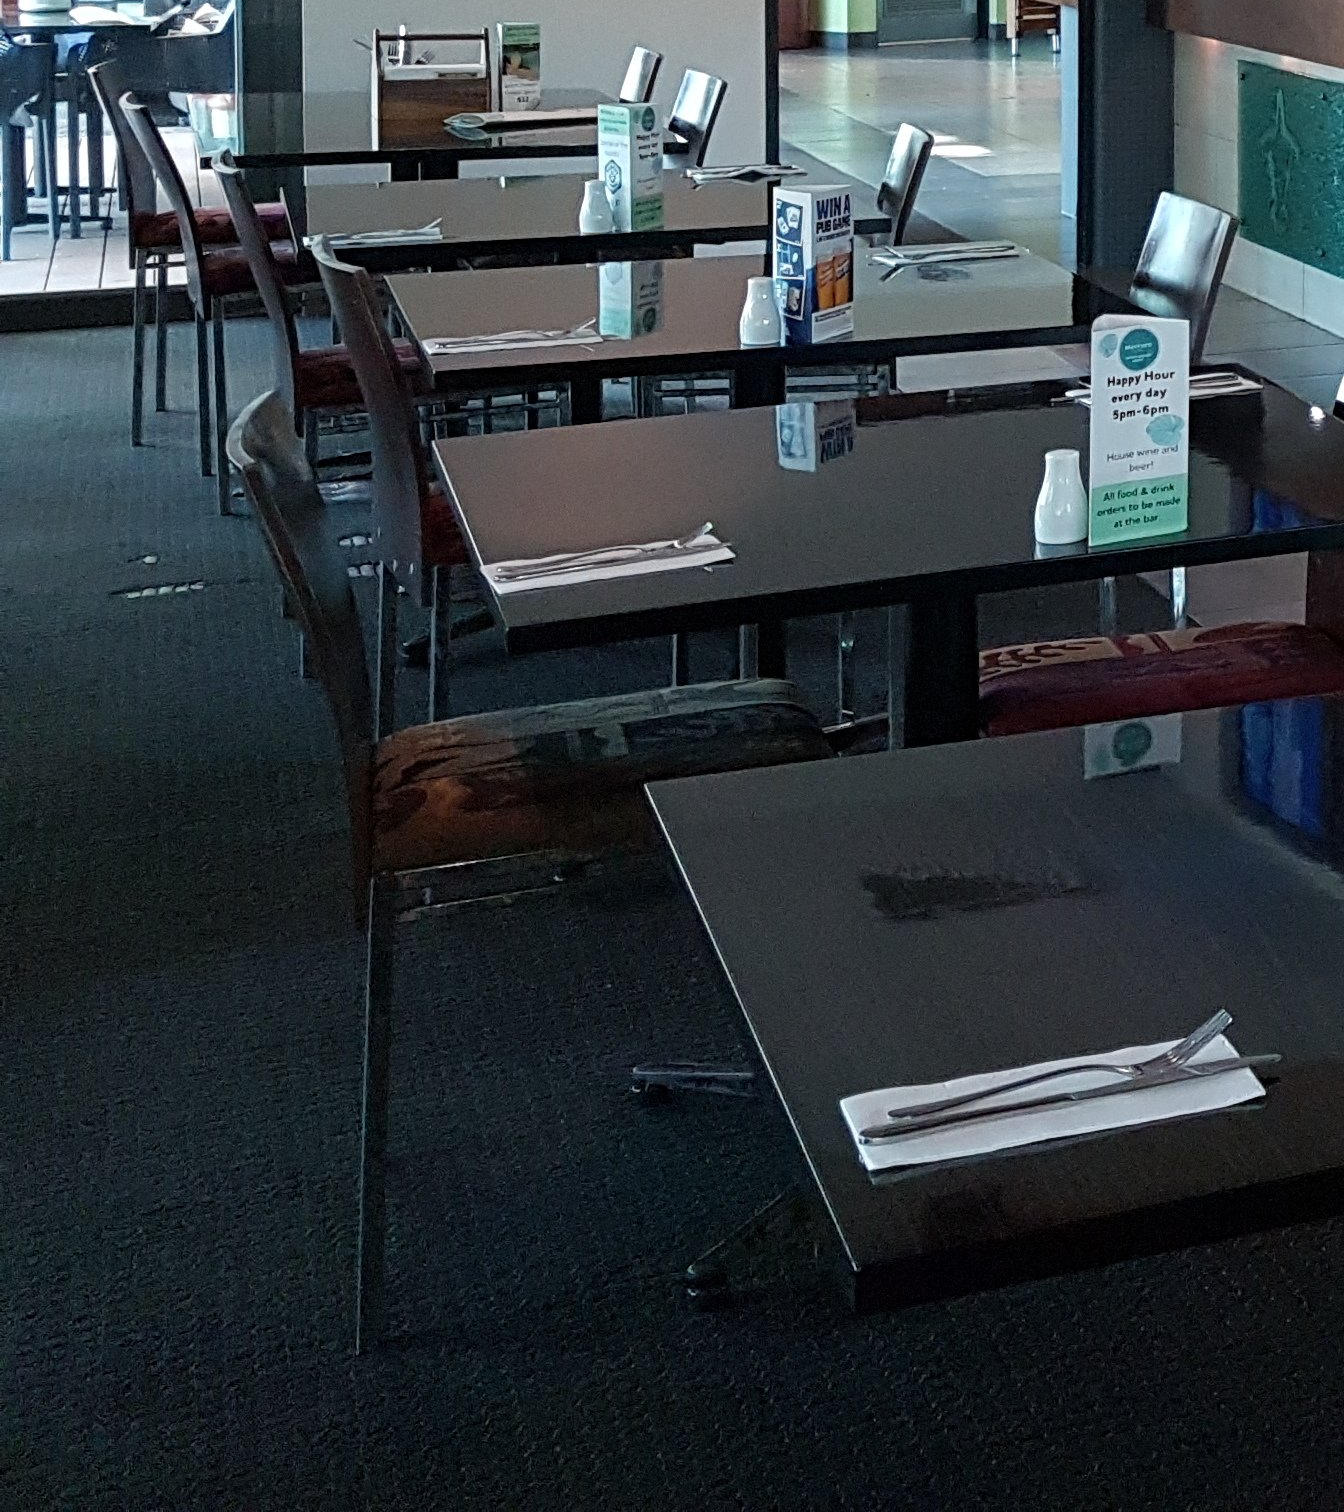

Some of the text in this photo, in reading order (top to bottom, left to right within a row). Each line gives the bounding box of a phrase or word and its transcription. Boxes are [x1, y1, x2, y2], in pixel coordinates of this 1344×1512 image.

[816, 193, 851, 220] WIN A
[1107, 370, 1175, 388] Happy Hour
[1111, 387, 1167, 403] every day
[1112, 404, 1169, 421] 5pm-6pm
[1103, 483, 1175, 502] All food & drink
[1128, 503, 1139, 511] to
[1155, 496, 1181, 508] made
[1125, 516, 1141, 526] the
